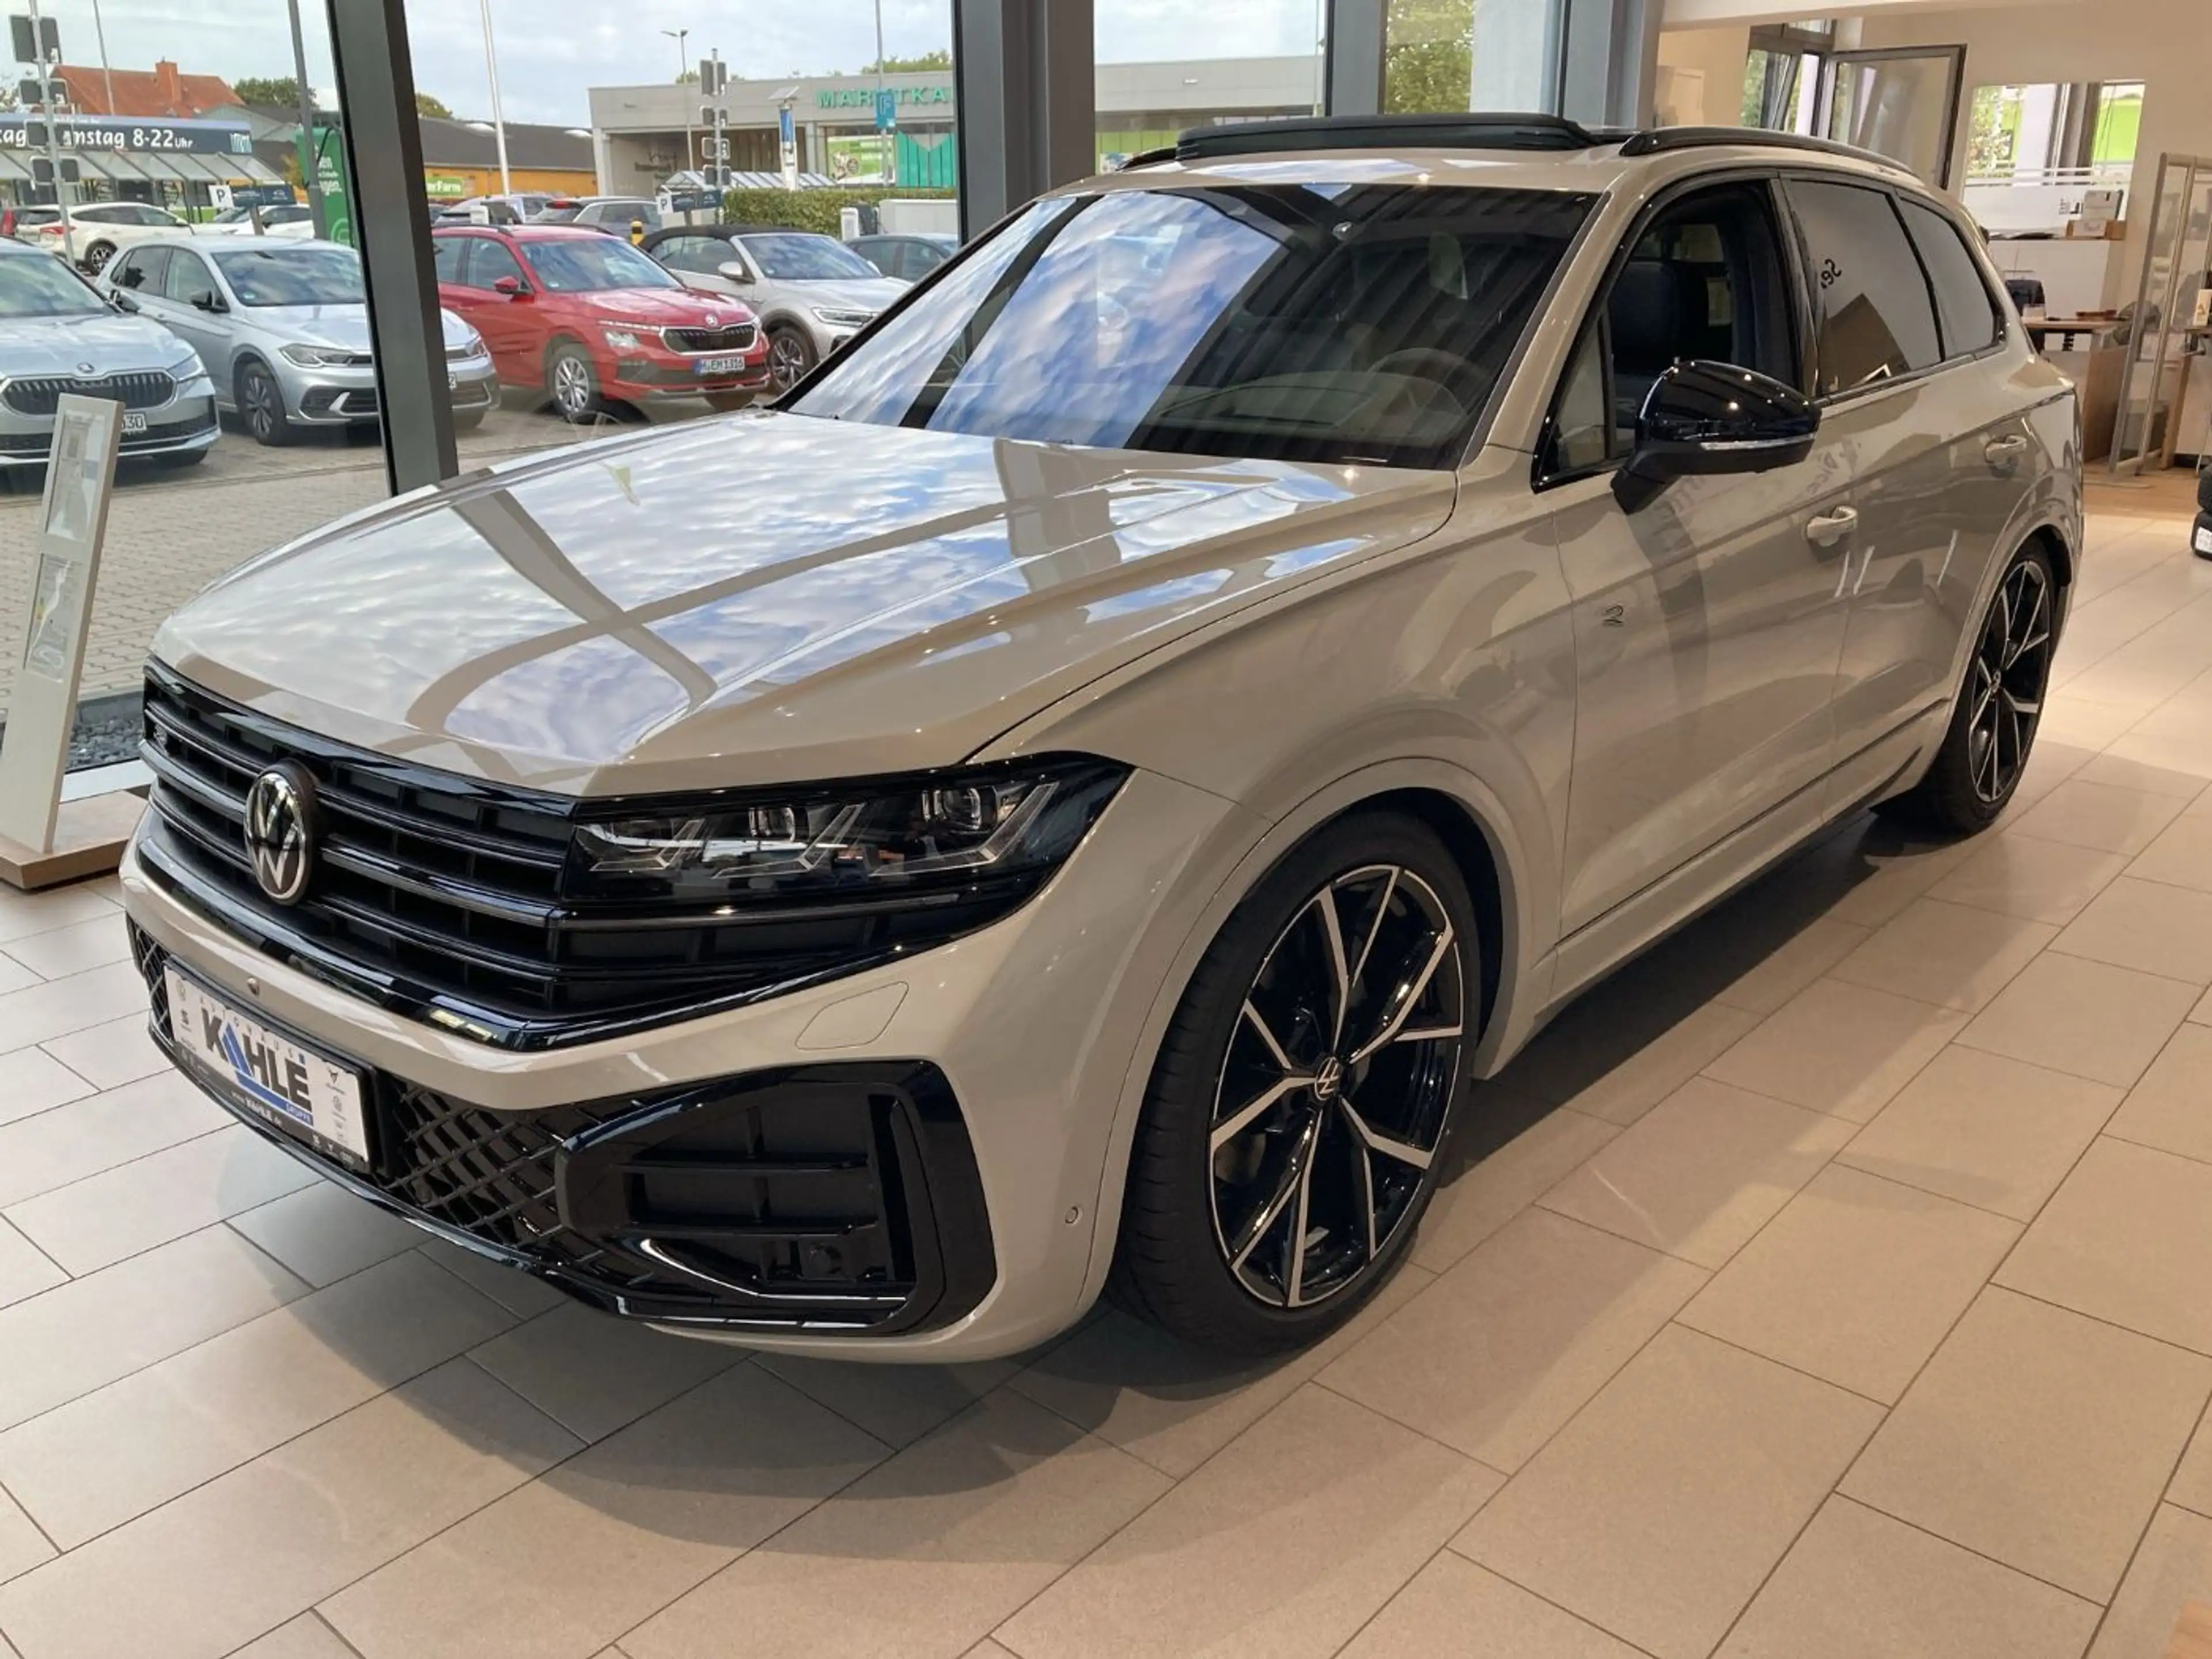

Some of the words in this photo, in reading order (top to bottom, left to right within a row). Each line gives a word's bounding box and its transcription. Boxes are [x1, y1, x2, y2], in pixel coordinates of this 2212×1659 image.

[817, 88, 949, 108] MARTKA
[132, 127, 174, 147] 8-22
[175, 137, 193, 149] Uhr
